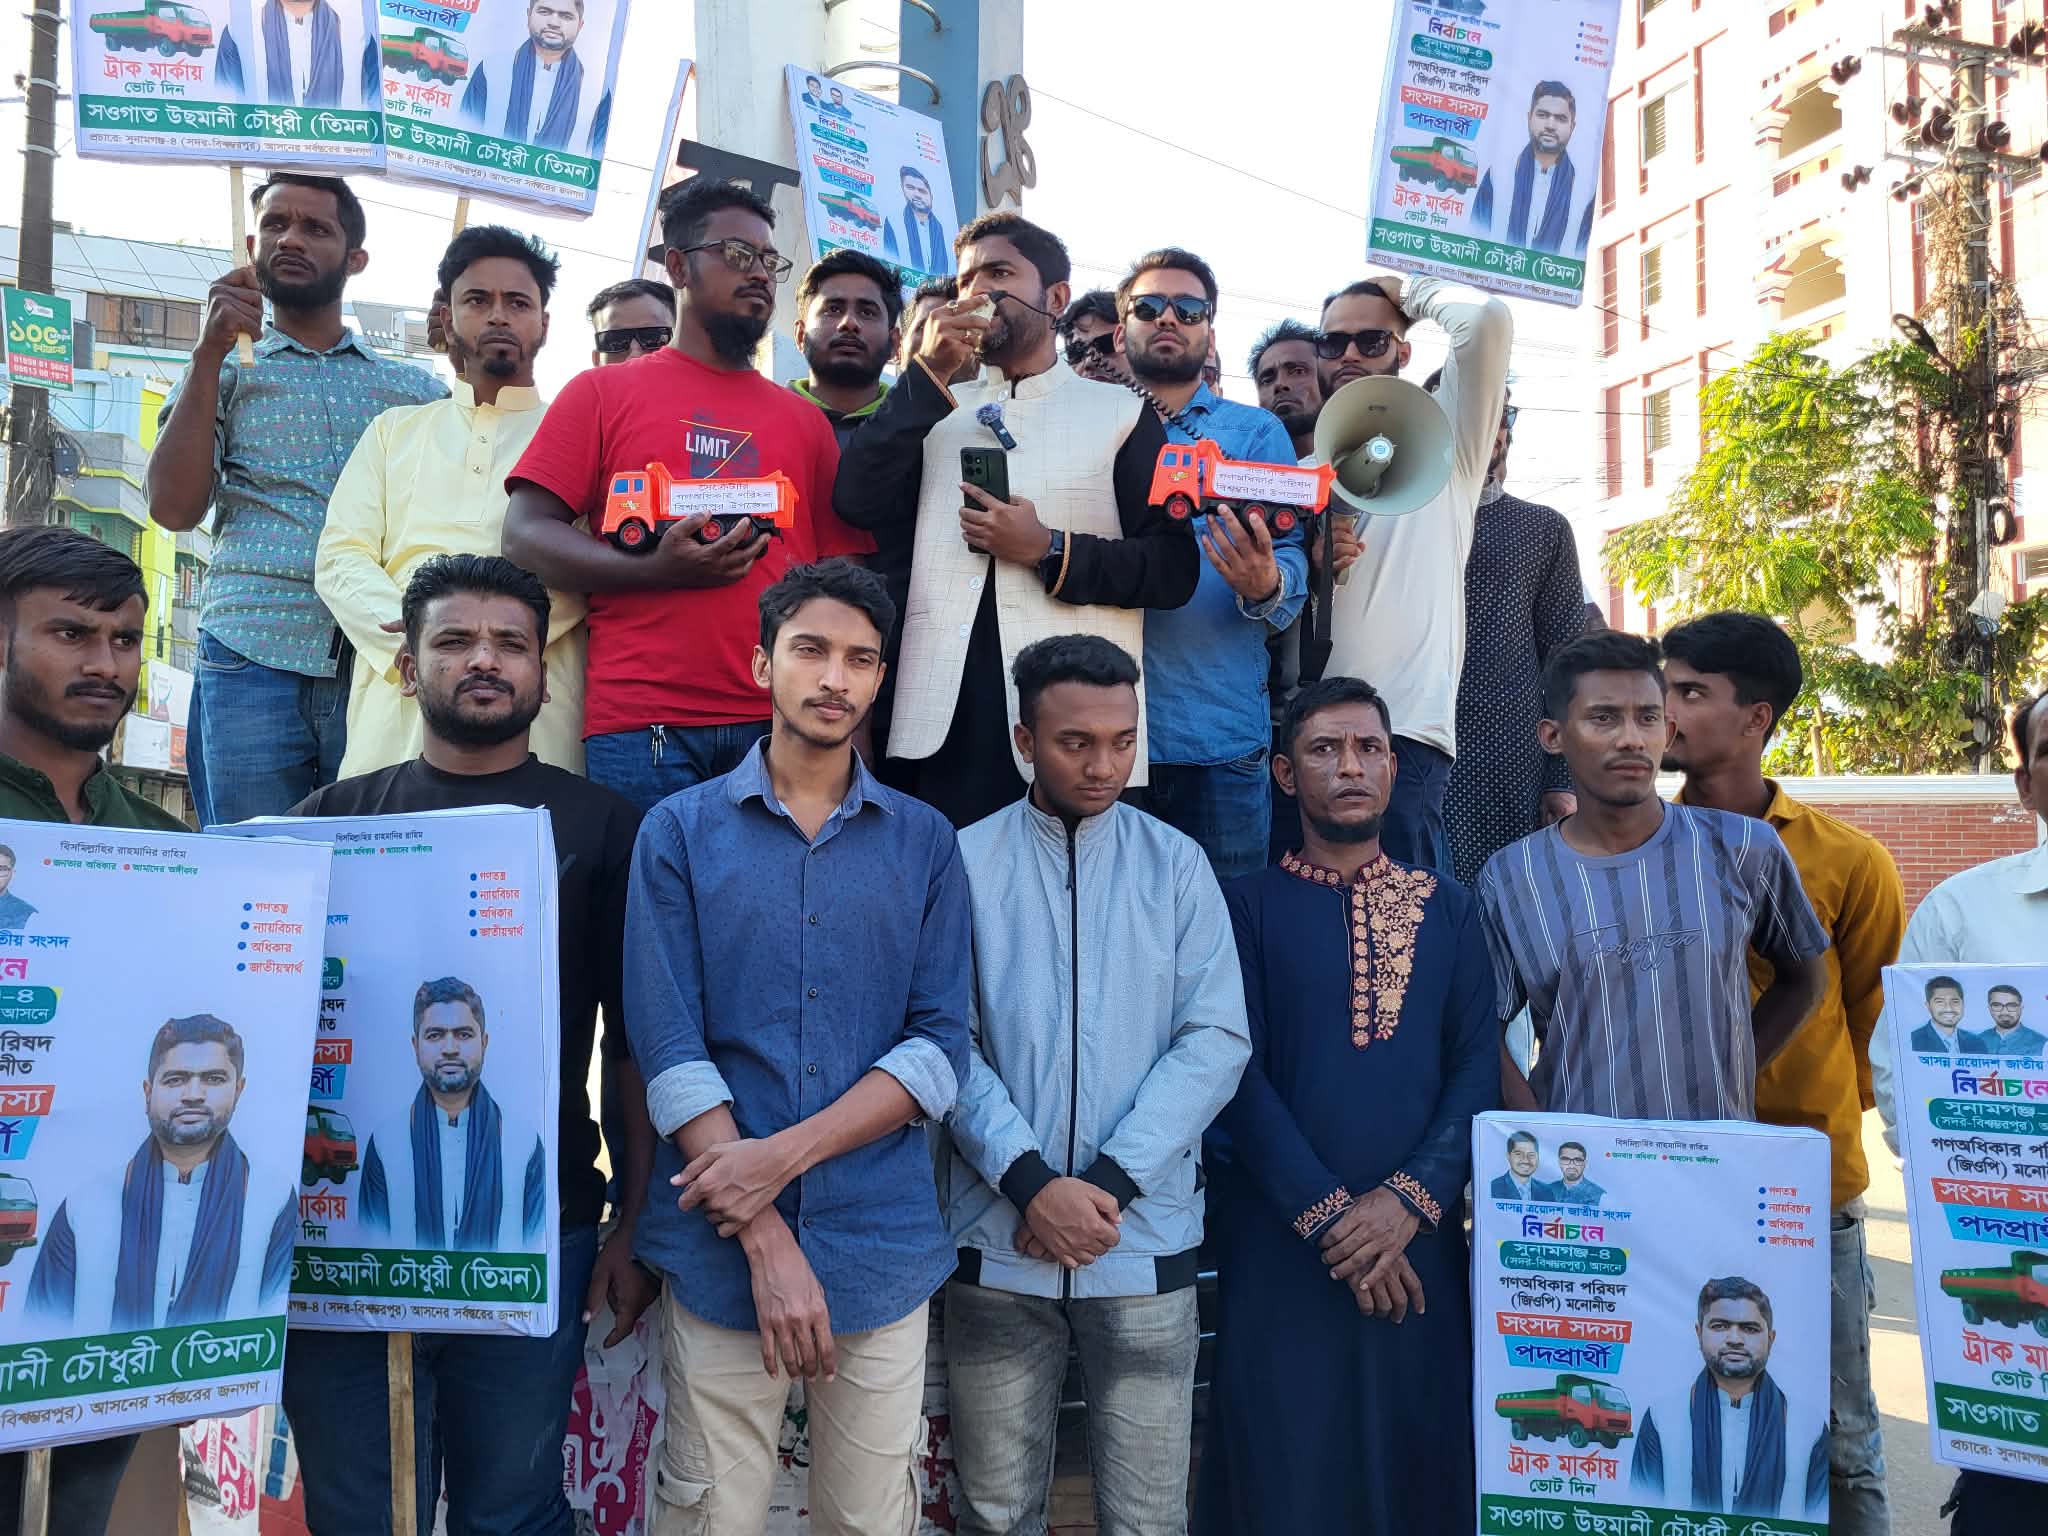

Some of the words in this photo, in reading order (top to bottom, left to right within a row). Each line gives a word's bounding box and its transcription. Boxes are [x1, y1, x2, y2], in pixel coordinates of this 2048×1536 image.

[387, 1, 460, 28] পদপ্রার্থী
[1428, 17, 1482, 45] নির্বাচনে
[103, 55, 142, 81] ট্রাক
[149, 57, 205, 82] মার্কায়
[124, 80, 155, 95] ভোট
[160, 80, 185, 96] দিন
[404, 82, 453, 109] মার্কায়
[87, 103, 160, 124] সওগাত
[164, 105, 238, 130] উছমানী
[243, 107, 303, 136] চৌধুরী
[310, 112, 379, 142] (তিমন)
[410, 102, 433, 119] দিন
[409, 124, 473, 156] উছমানী
[476, 139, 530, 170] চৌধুরী
[535, 153, 596, 186] (তিমন)
[1391, 184, 1421, 211] ট্রাক
[1425, 194, 1465, 217] মার্কায়
[1404, 208, 1427, 223] ভোট
[1429, 212, 1449, 229] দিন
[1375, 226, 1424, 250] সওগাত
[1429, 233, 1481, 263] উছমানী
[1484, 247, 1529, 275] চৌধুরী
[1531, 256, 1584, 286] (তিমন)
[685, 431, 731, 459] LIMIT
[252, 919, 304, 936] ন্যায়বিচার
[326, 914, 351, 926] ংসদ
[0, 929, 25, 947] তীয়
[29, 934, 71, 949] সংসদ
[249, 940, 293, 954] অধিকার
[0, 1030, 57, 1053] রিষদ
[315, 1042, 347, 1063] দস্য
[1944, 1100, 2048, 1119] সুনামগঞ্জ-
[1931, 1136, 2022, 1159] গণঅধিকার
[1947, 1156, 2008, 1180] (জিওপি)
[299, 1186, 348, 1221] ার্কায়
[1938, 1180, 2011, 1206] সংসদ
[303, 1220, 329, 1242] দিন
[1521, 1214, 1605, 1244] নির্বাচনে
[1957, 1214, 2048, 1244] পদপ্রা
[1513, 1243, 1611, 1262] সুনামগঞ্জ-৪
[307, 1252, 383, 1288] উছমানী
[389, 1253, 454, 1294] চৌধুরী
[460, 1256, 542, 1300] (তিমন)
[1500, 1275, 1575, 1295] গণঅধিকার
[1580, 1278, 1627, 1298] পরিষদ
[1511, 1292, 1562, 1312] (জিওপি)
[1566, 1294, 1617, 1315] মনোনীত
[1502, 1314, 1562, 1338] সংসদ
[1569, 1318, 1627, 1343] সদস্য
[62, 1335, 163, 1385] চৌধুরী
[171, 1327, 277, 1379] (তিমন)
[1515, 1340, 1613, 1371] পদপ্রার্থী
[1962, 1326, 2014, 1366] ট্রাক
[1991, 1368, 2034, 1390] ভোট
[90, 1395, 148, 1415] আসনের
[1944, 1396, 2041, 1434] সওগাত
[1507, 1443, 1550, 1480] ট্রাক
[1558, 1448, 1620, 1481] মার্কায়
[1529, 1475, 1565, 1494] ভোট
[1569, 1478, 1597, 1497] দিন
[1487, 1505, 1568, 1531] সওগাত
[1572, 1504, 1655, 1535] উছমানী
